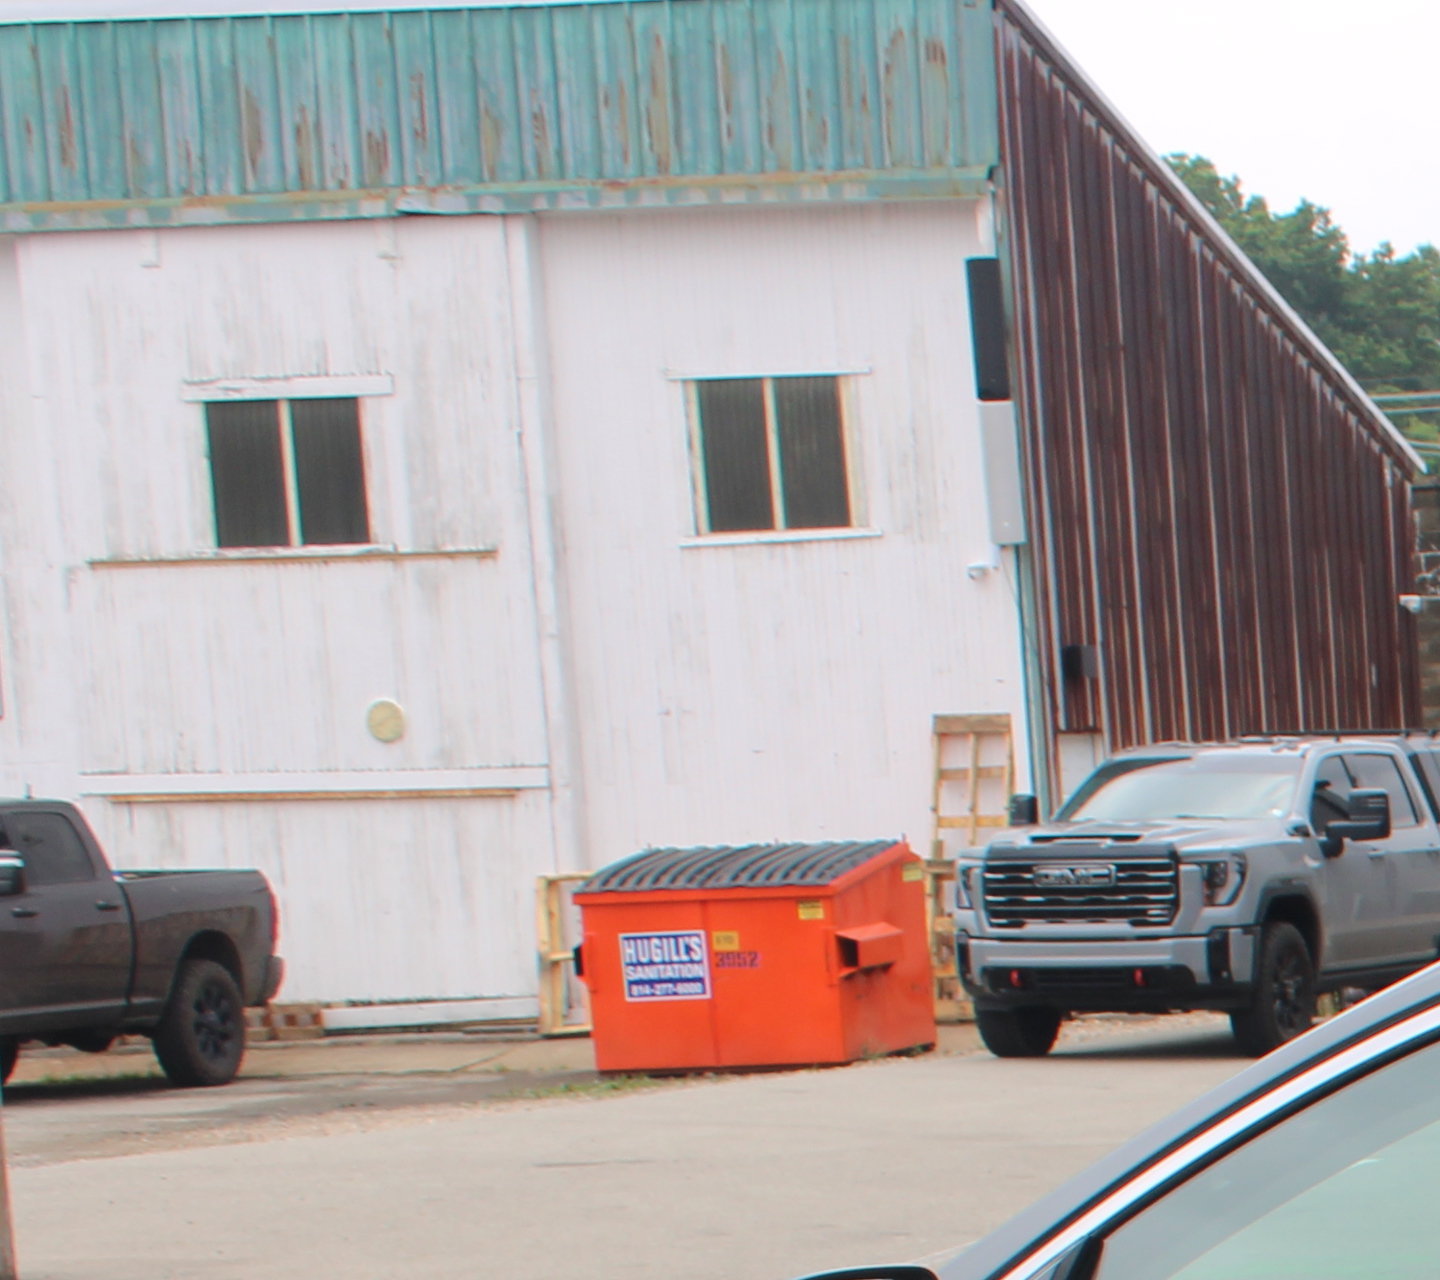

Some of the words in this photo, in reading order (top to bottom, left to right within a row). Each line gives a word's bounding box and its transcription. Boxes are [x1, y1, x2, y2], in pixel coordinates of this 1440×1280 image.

[1036, 868, 1111, 886] GMC
[623, 935, 702, 964] HUGILL'S
[626, 963, 704, 981] SANITATION
